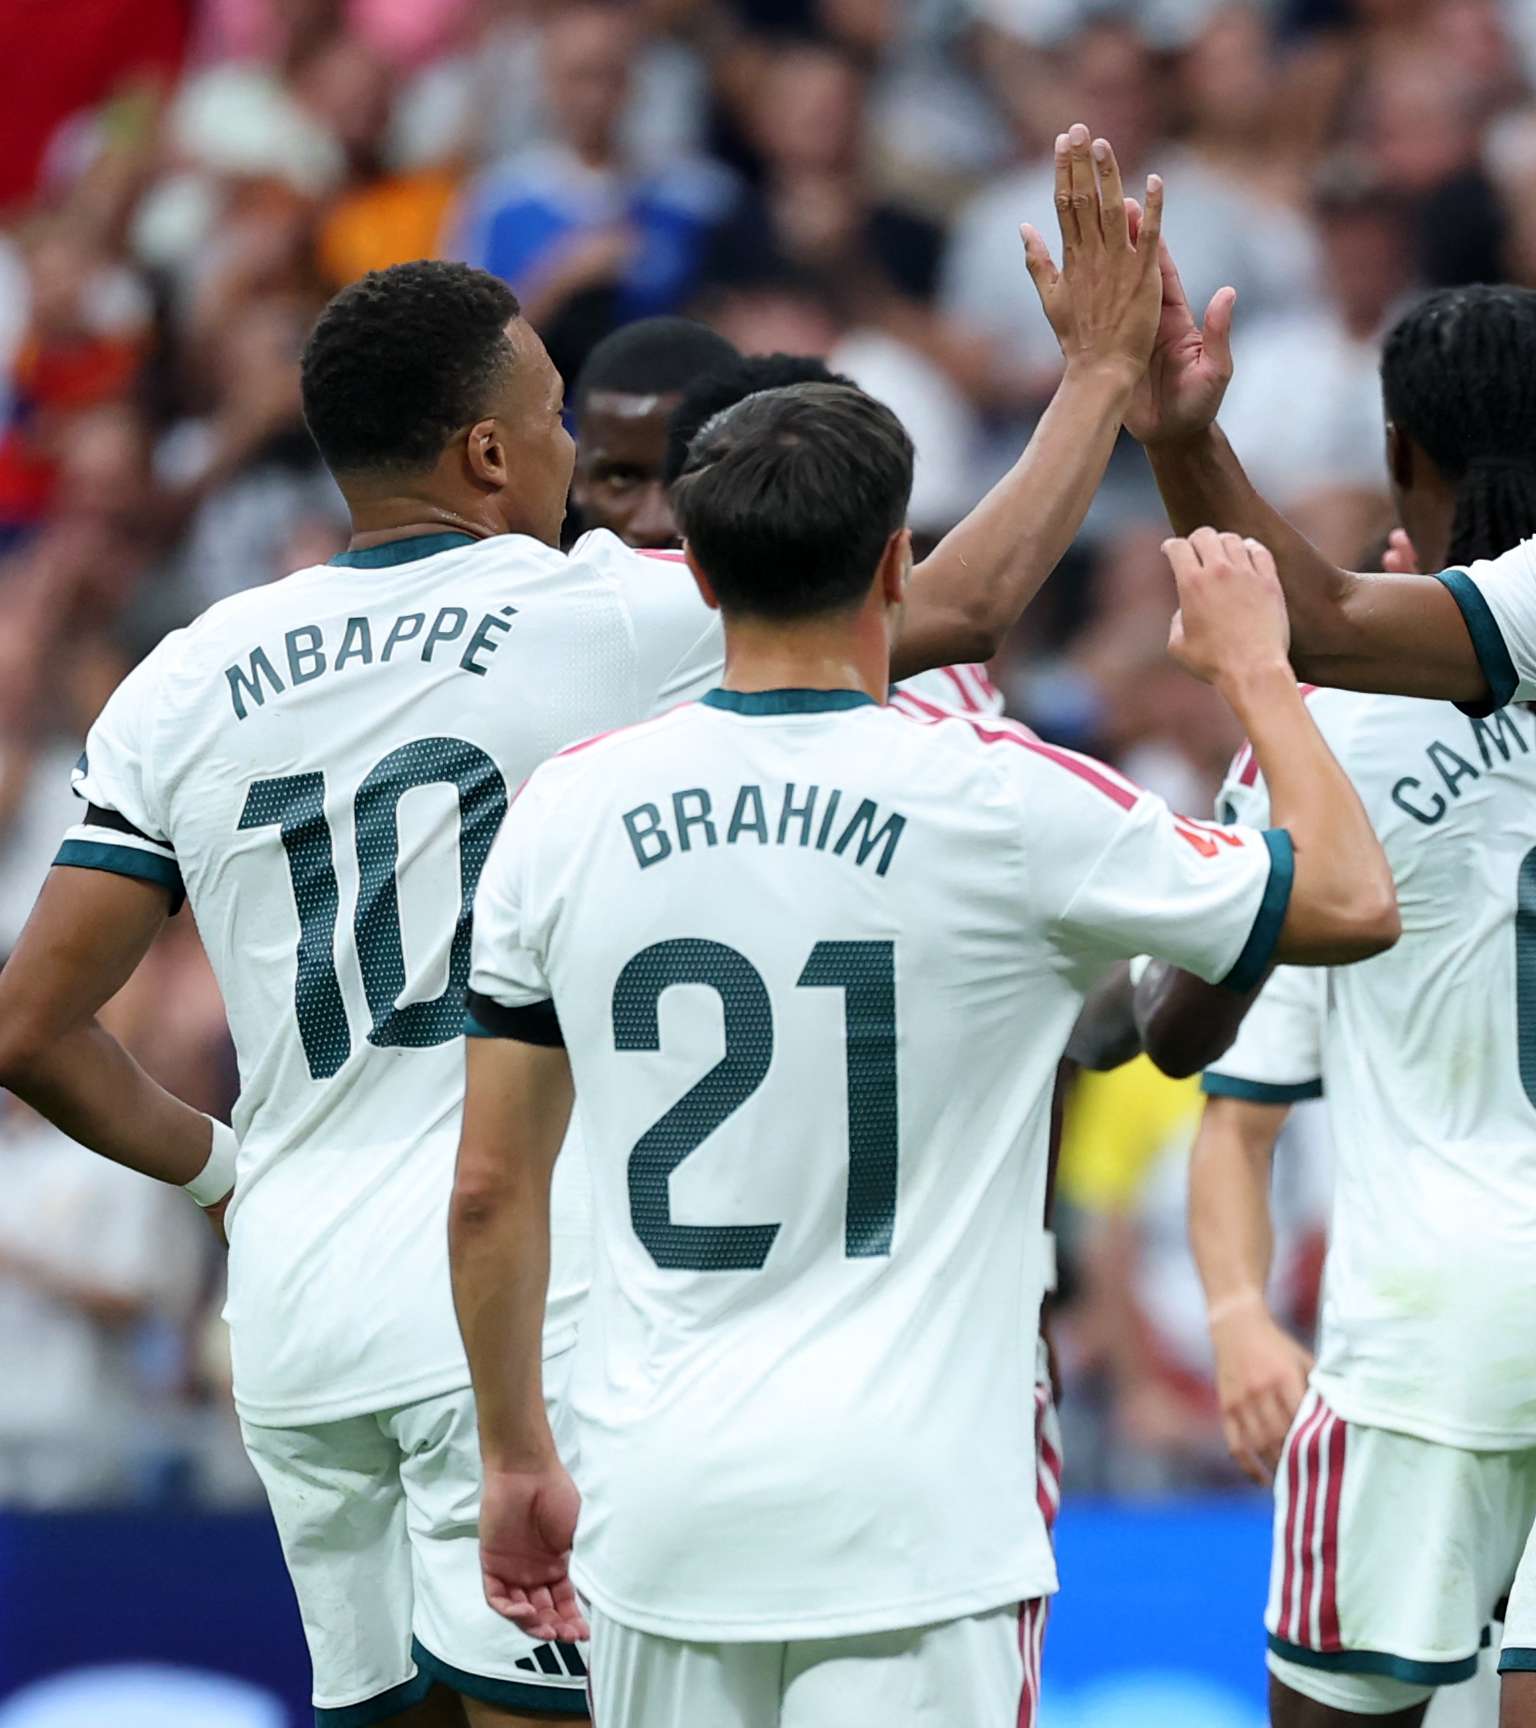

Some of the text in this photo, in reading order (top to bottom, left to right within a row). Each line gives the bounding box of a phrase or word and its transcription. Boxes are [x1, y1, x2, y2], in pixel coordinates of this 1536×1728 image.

[225, 606, 519, 720] MBAPPÉ
[237, 736, 509, 1080] 10
[621, 782, 907, 877] BRAHIM
[612, 937, 898, 1270] 21
